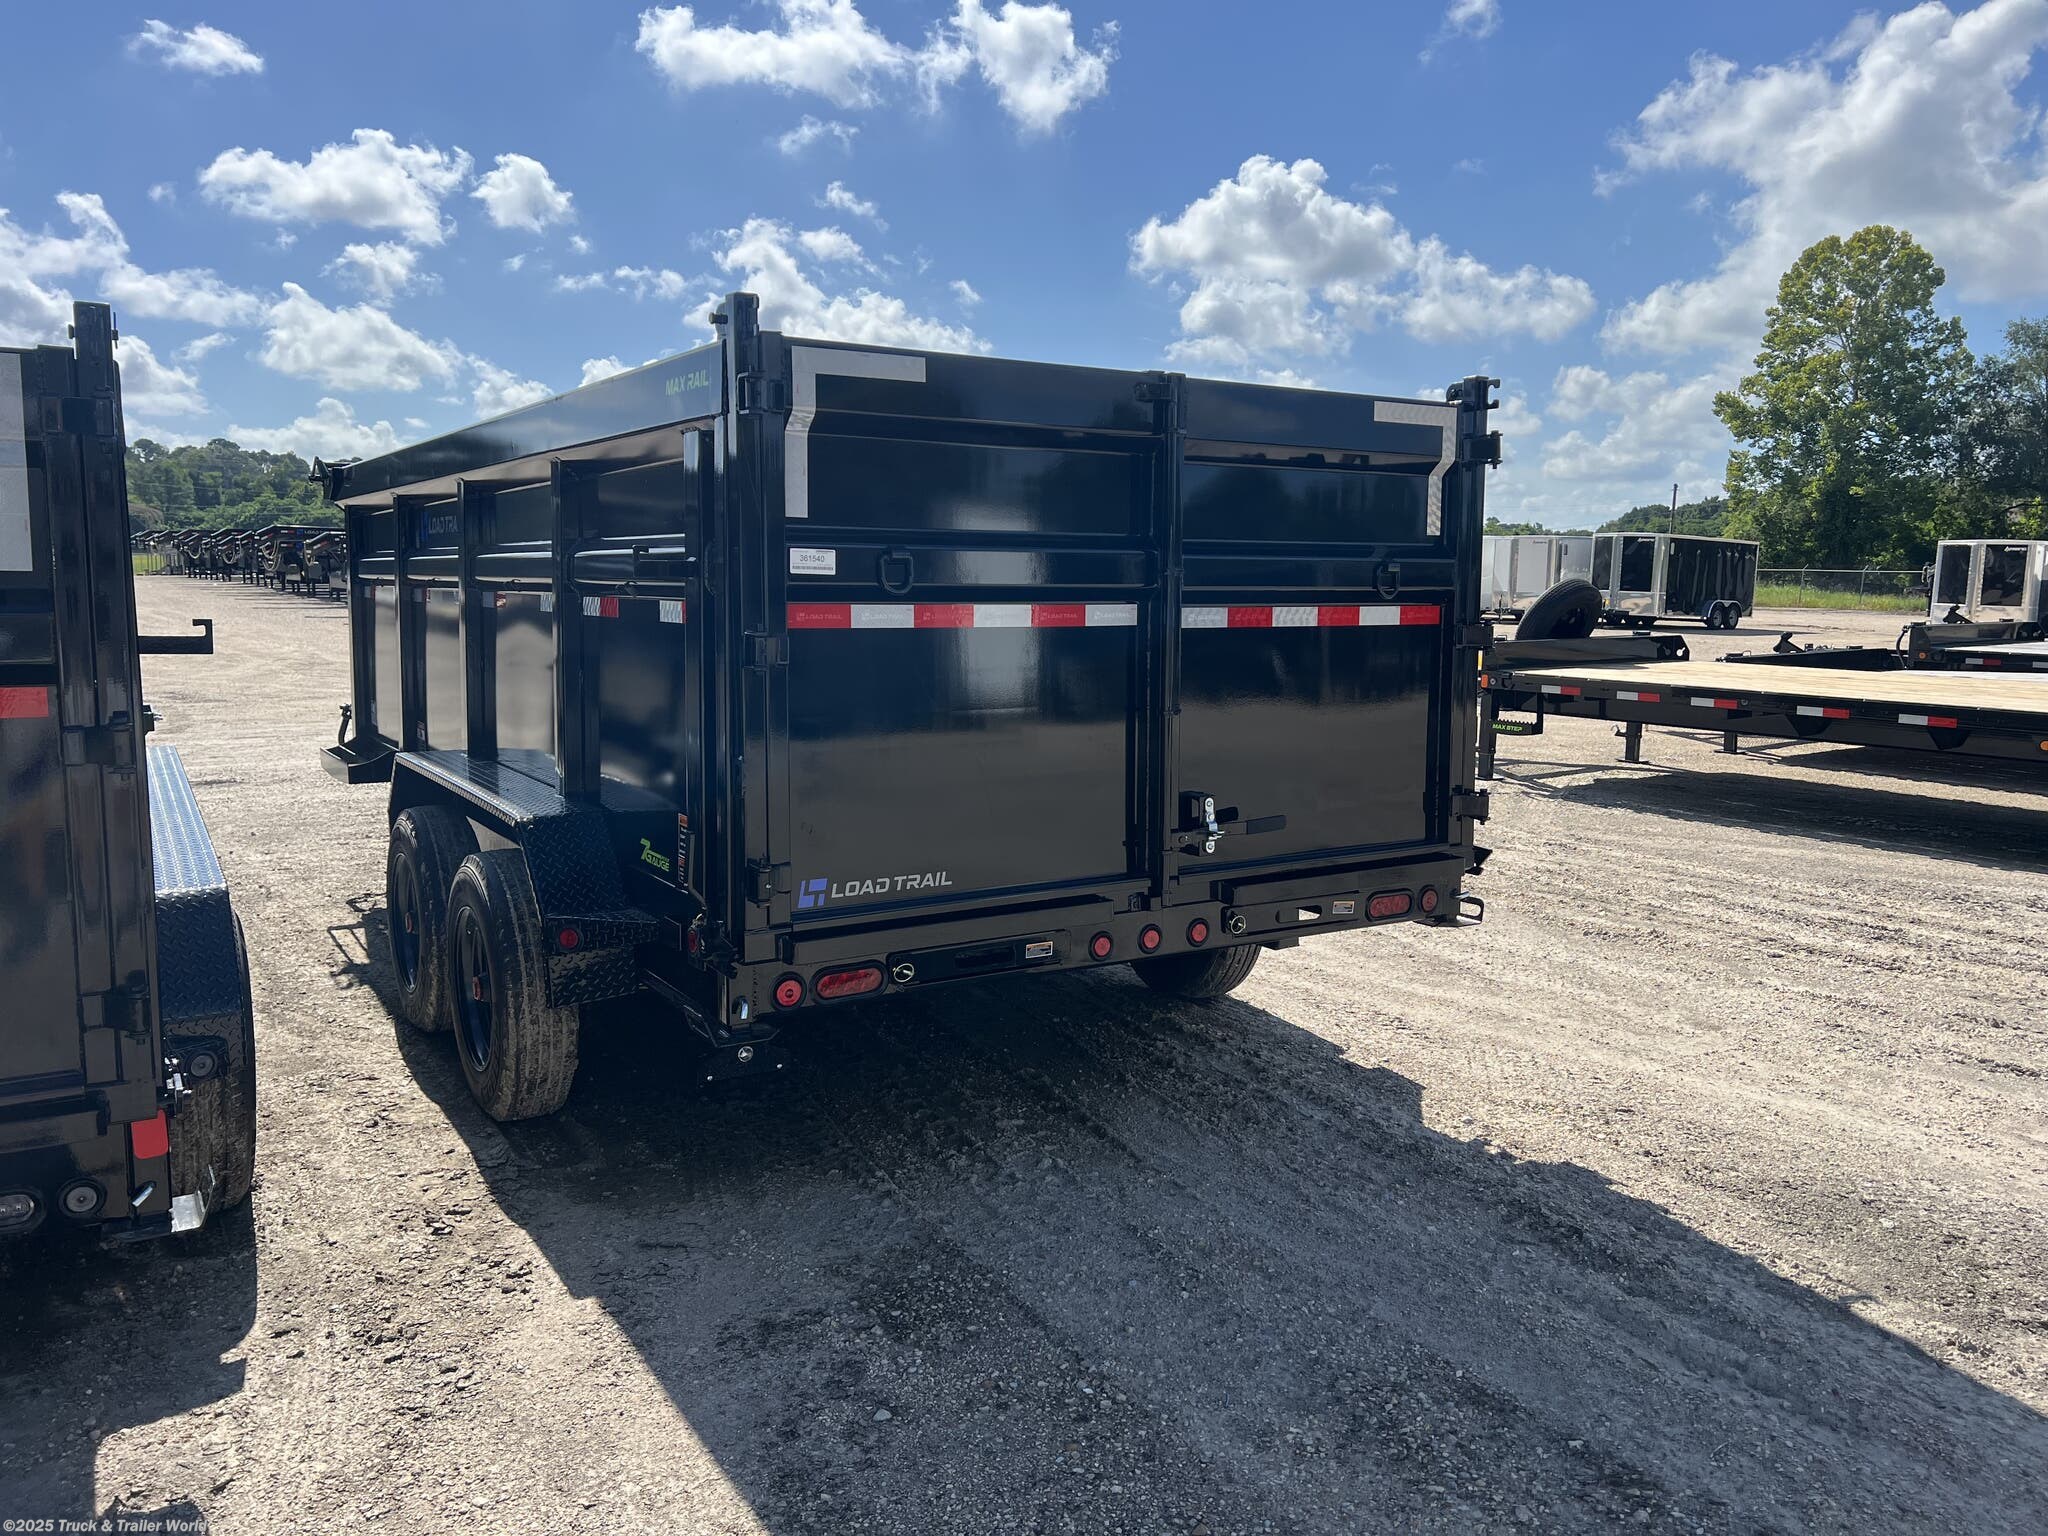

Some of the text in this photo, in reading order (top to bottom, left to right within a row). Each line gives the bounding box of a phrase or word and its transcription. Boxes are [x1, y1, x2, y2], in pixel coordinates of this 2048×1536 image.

[666, 369, 709, 396] MAX RAIL
[646, 853, 670, 872] GAUGE
[831, 871, 953, 899] LOAD TRAIL
